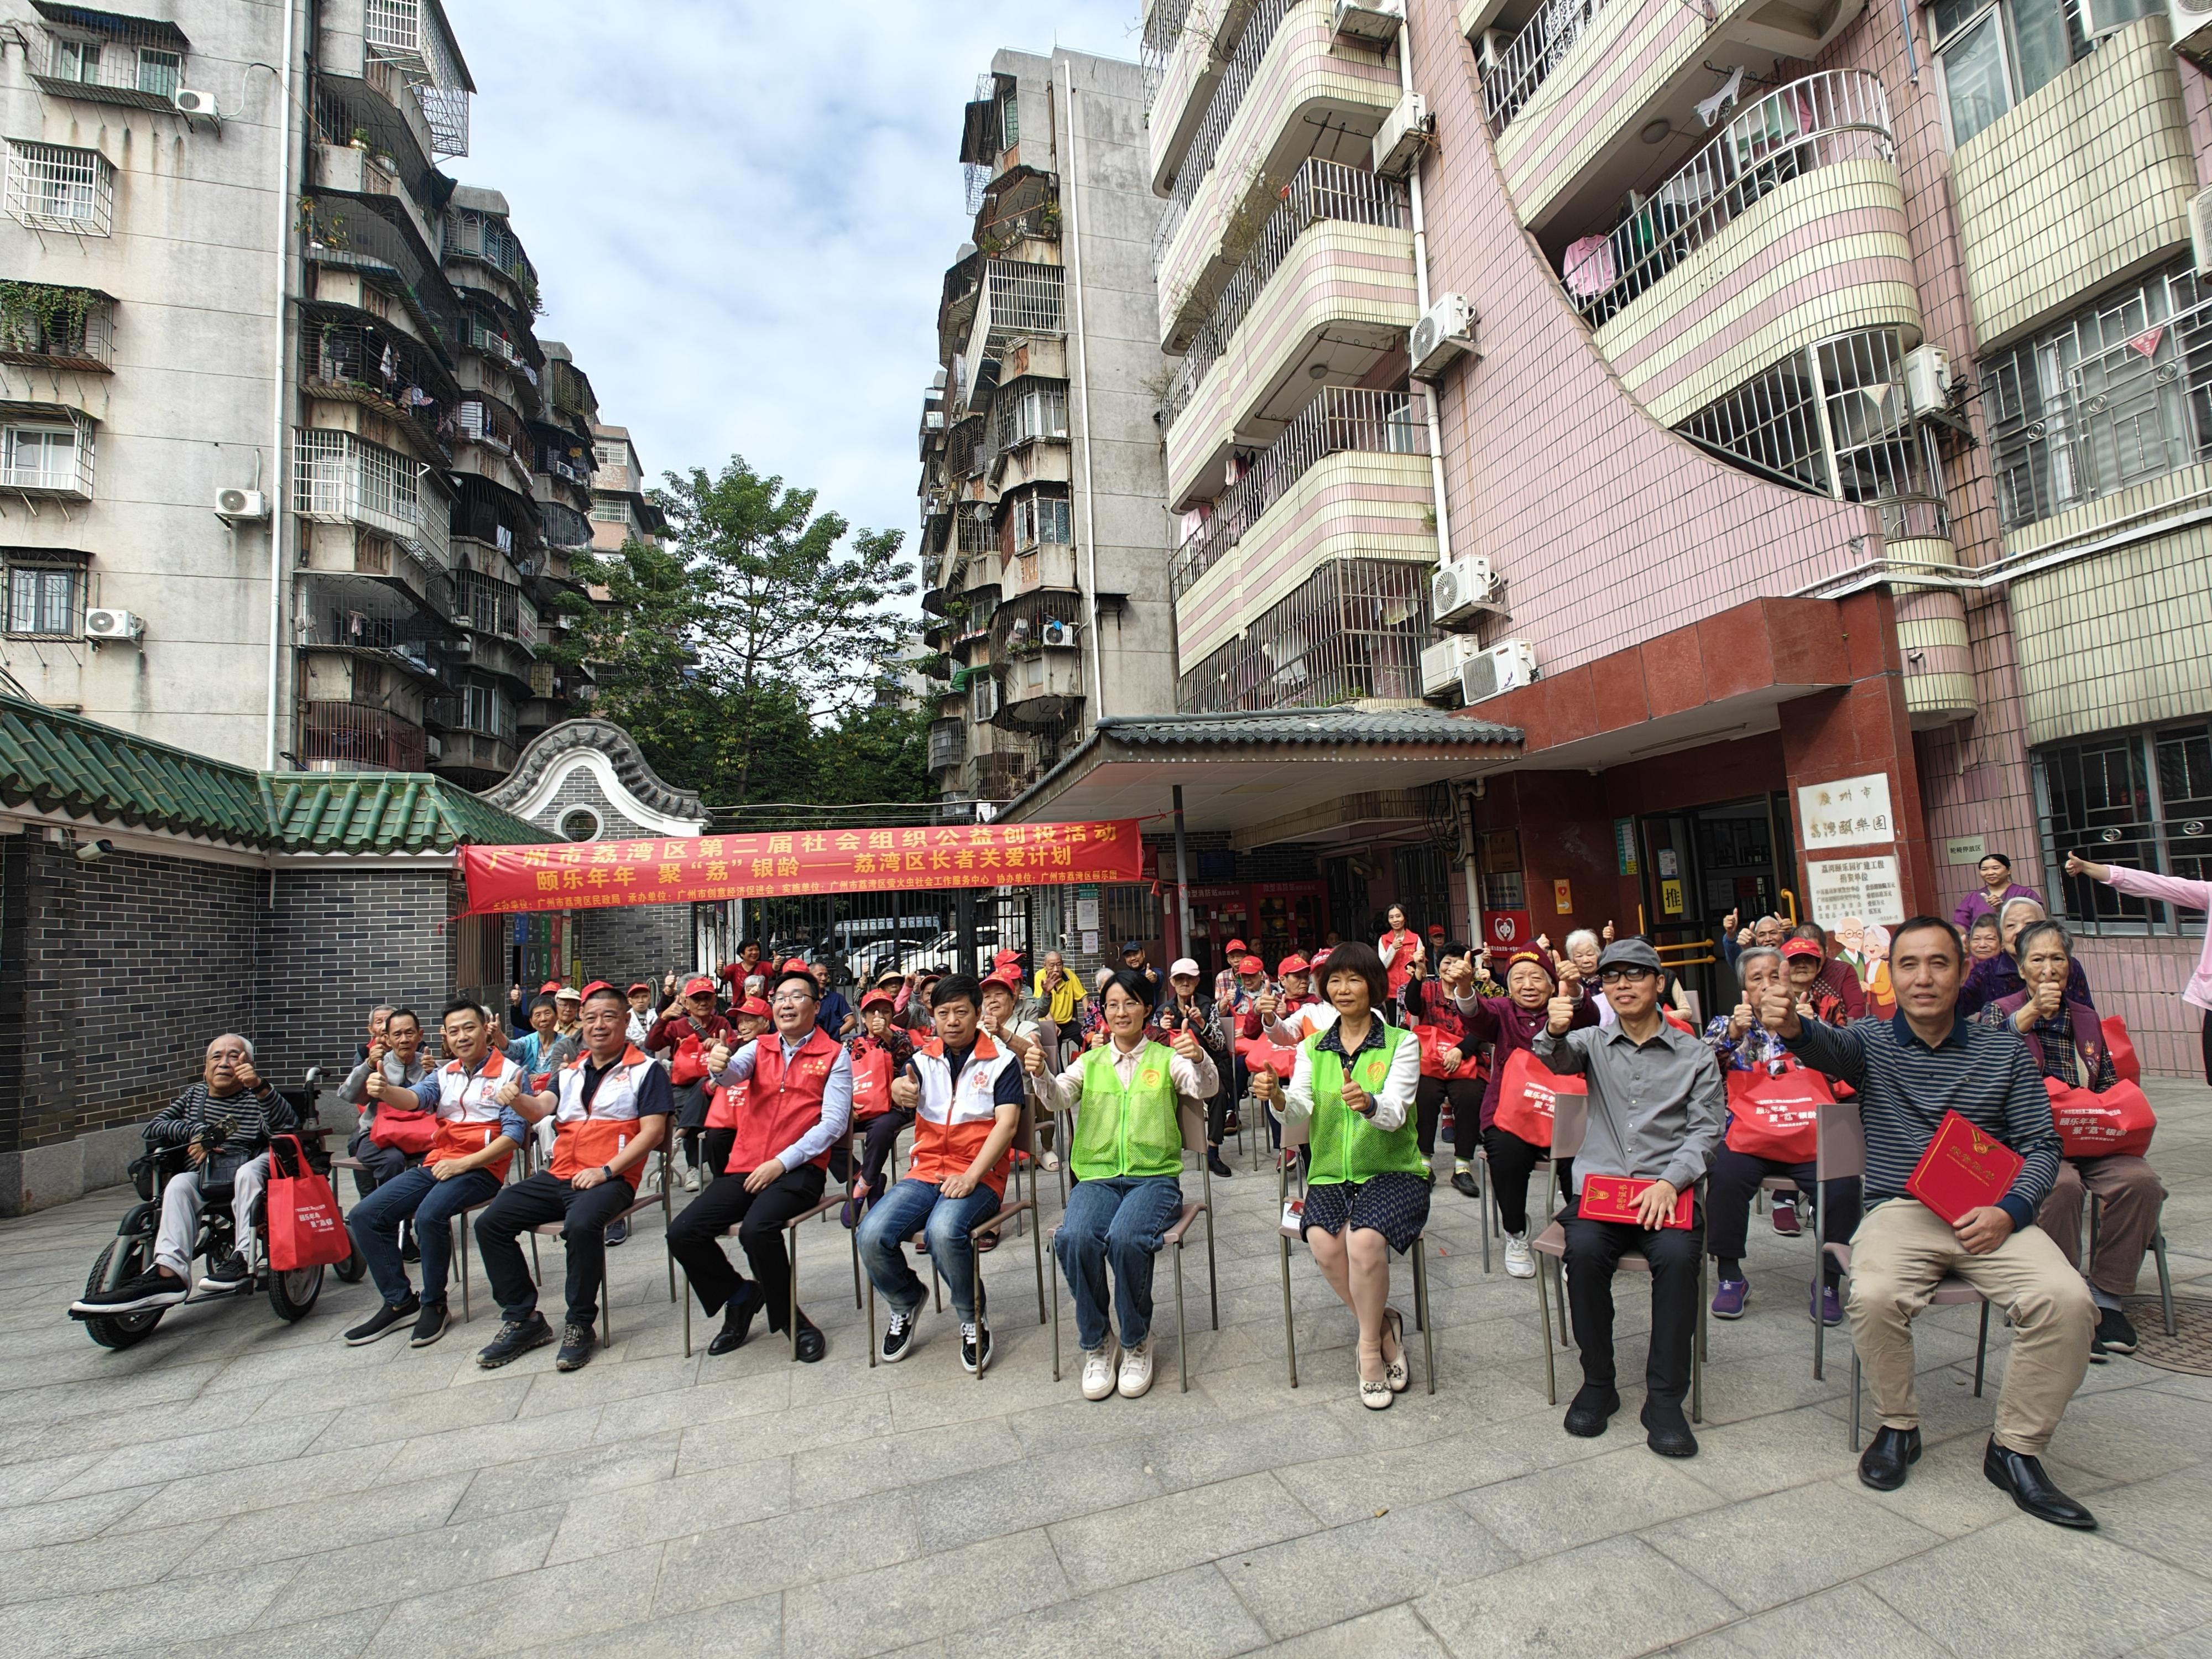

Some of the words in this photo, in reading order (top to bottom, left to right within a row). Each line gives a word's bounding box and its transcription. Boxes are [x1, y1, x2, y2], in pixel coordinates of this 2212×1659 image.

[487, 823, 1117, 870] 广州市荔湾区第二届社会组织公益创投活动
[1665, 888, 1682, 908] 推
[2059, 1118, 2098, 1126] 颐乐年年
